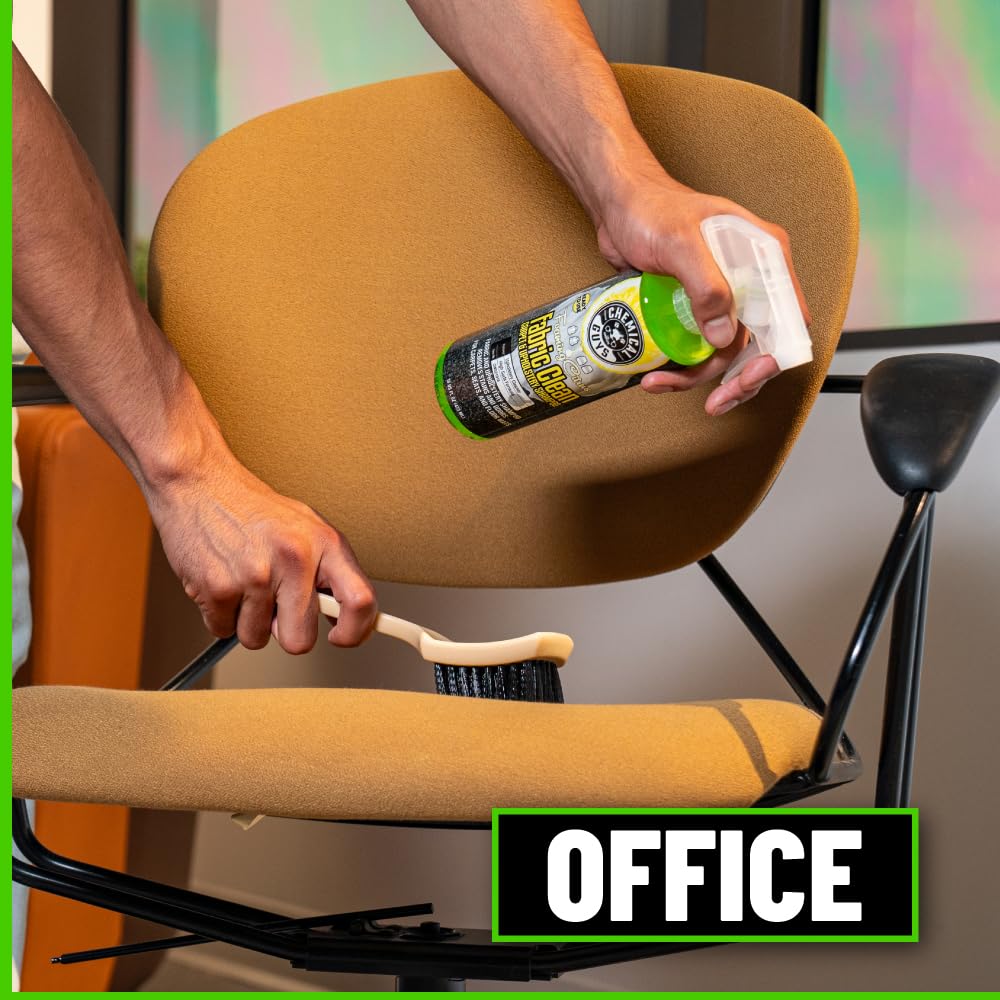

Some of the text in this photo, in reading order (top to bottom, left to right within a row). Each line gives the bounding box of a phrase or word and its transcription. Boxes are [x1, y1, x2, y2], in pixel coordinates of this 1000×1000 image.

[591, 323, 610, 358] GUYS
[608, 306, 639, 359] CHEMICAL
[519, 348, 540, 390] UPHOLSTERY
[526, 309, 581, 405] Fabric Clean
